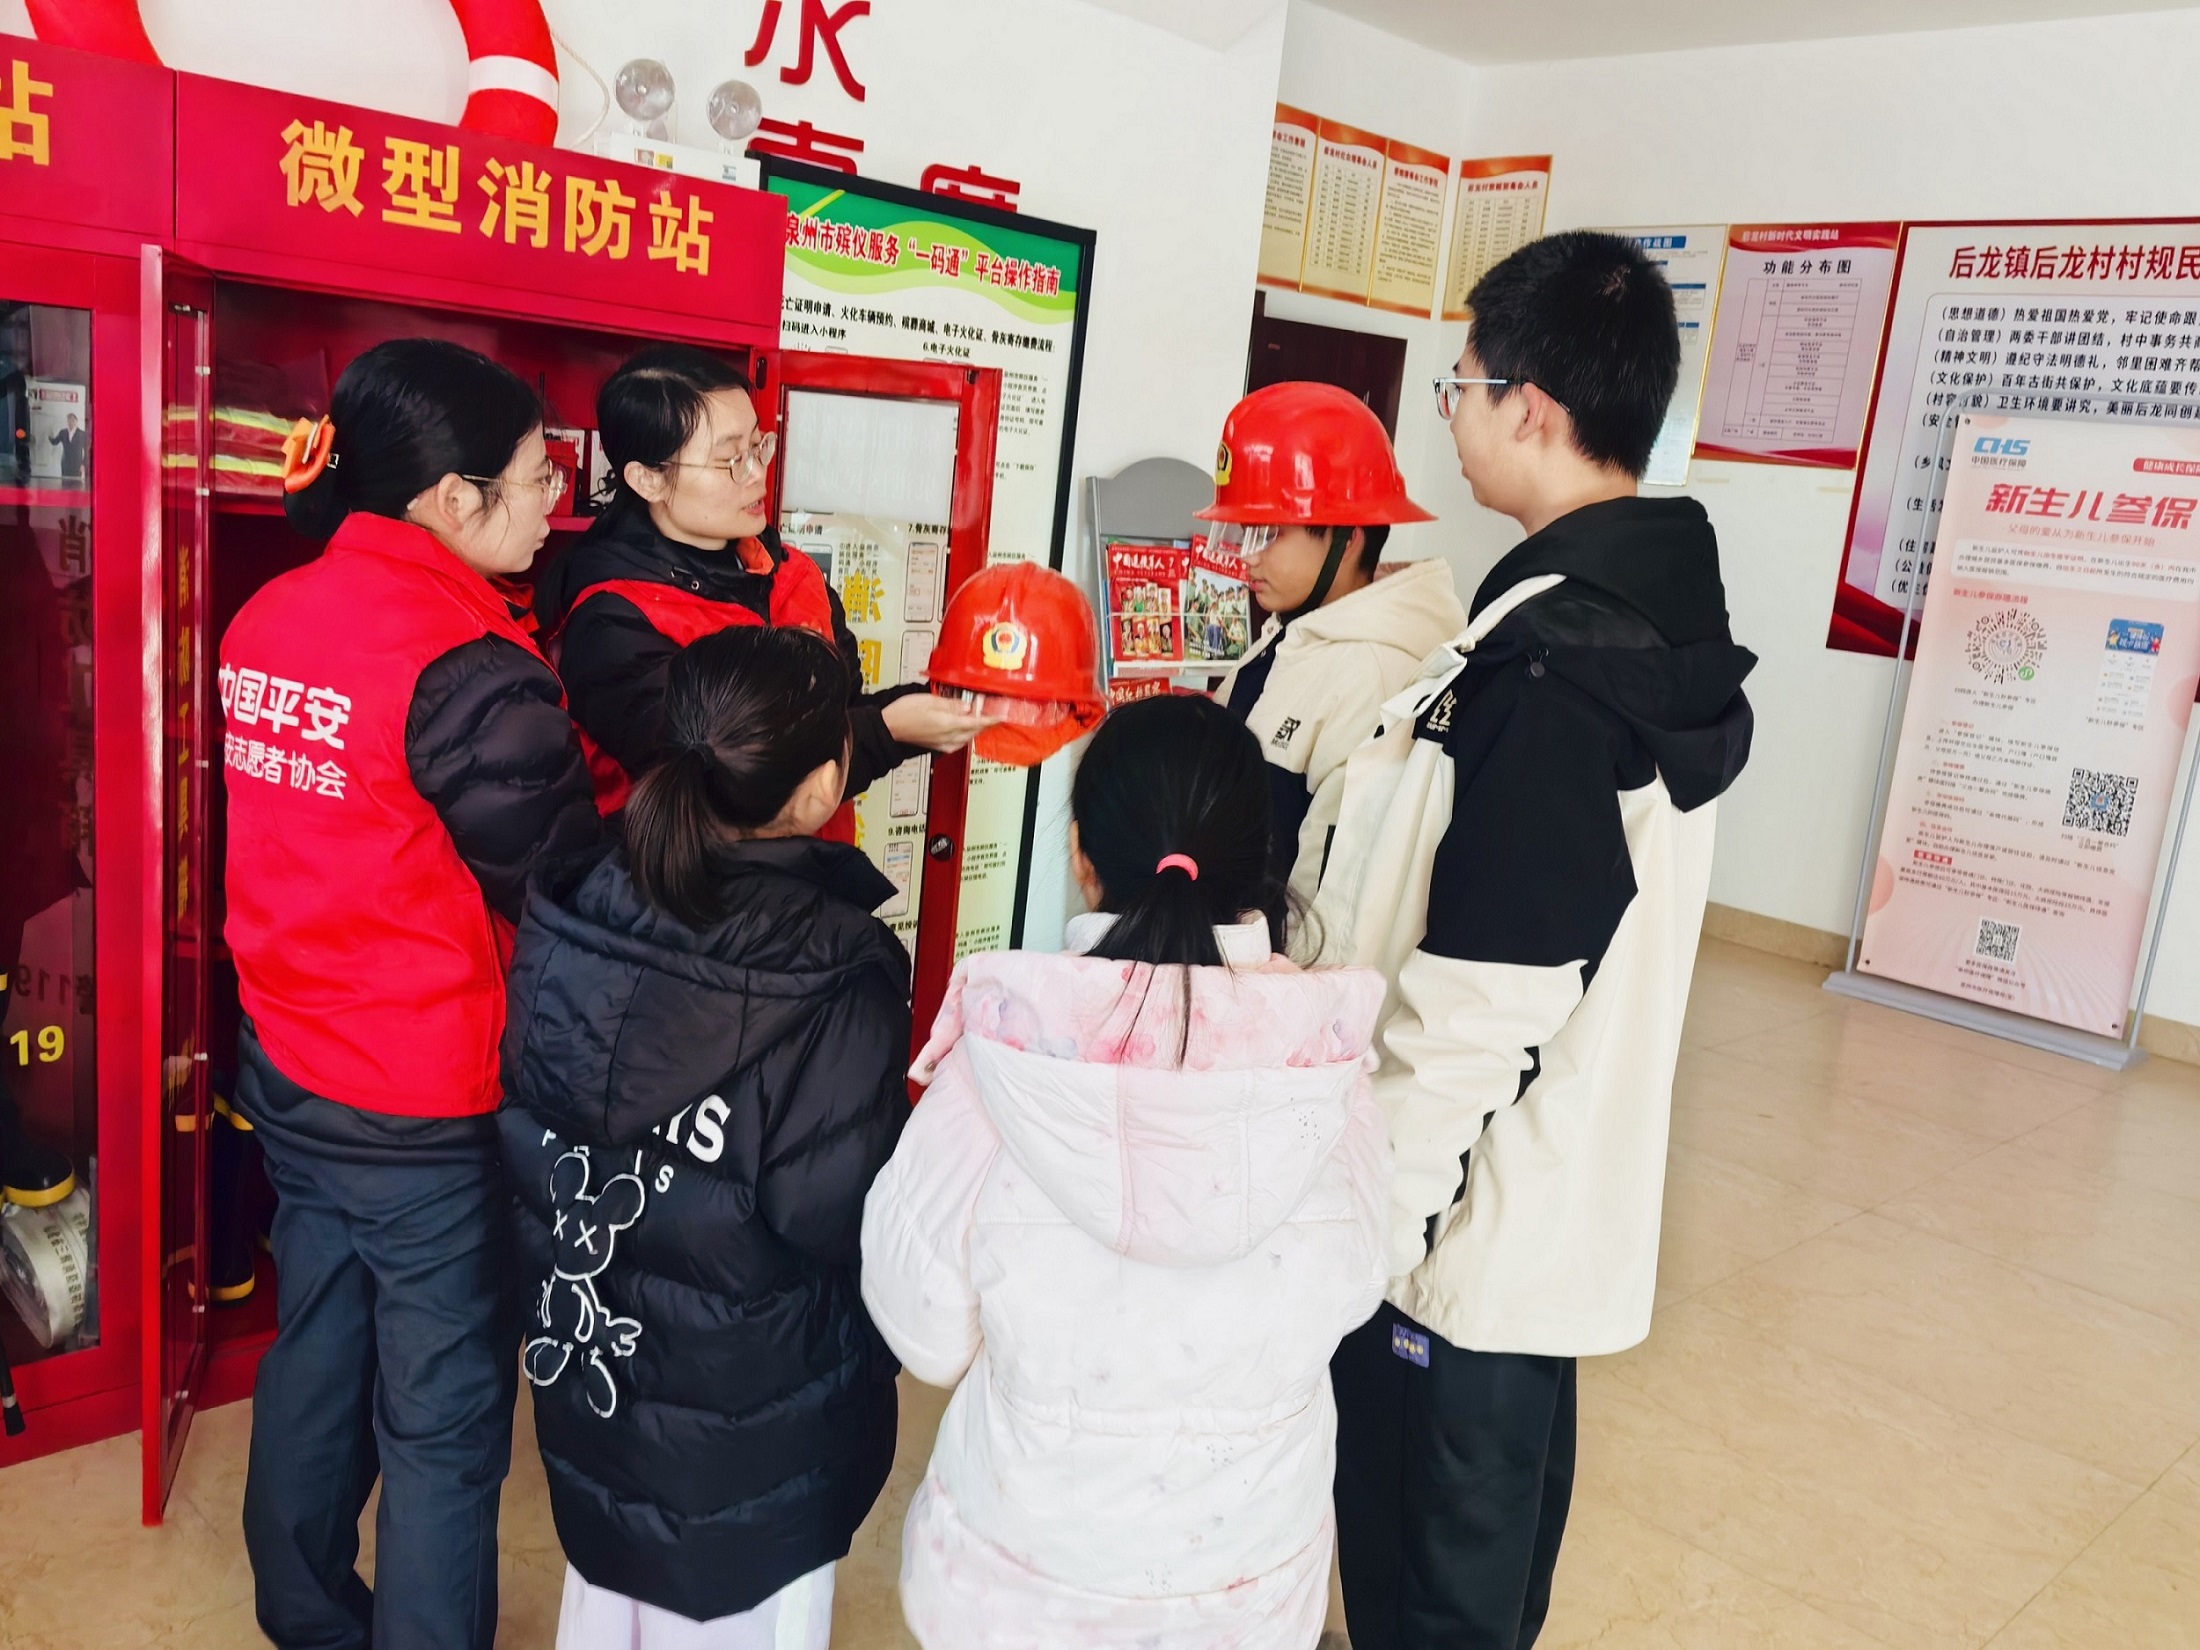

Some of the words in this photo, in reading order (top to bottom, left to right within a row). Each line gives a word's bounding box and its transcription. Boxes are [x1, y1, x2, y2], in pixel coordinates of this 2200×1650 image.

[280, 120, 714, 276] 微型消防站
[1763, 259, 1851, 275] 功能分布图
[1942, 306, 2200, 326] （思想道德）热爱祖国热爱党，牢记使命跟
[1930, 372, 2200, 397] （文化保护）百年古街共保护，文化底蕴要传
[1974, 436, 2031, 456] CHS
[1971, 455, 2027, 469] 中国医疗保障
[1985, 483, 2198, 530] 新生儿参保
[218, 662, 352, 750] 中国平安
